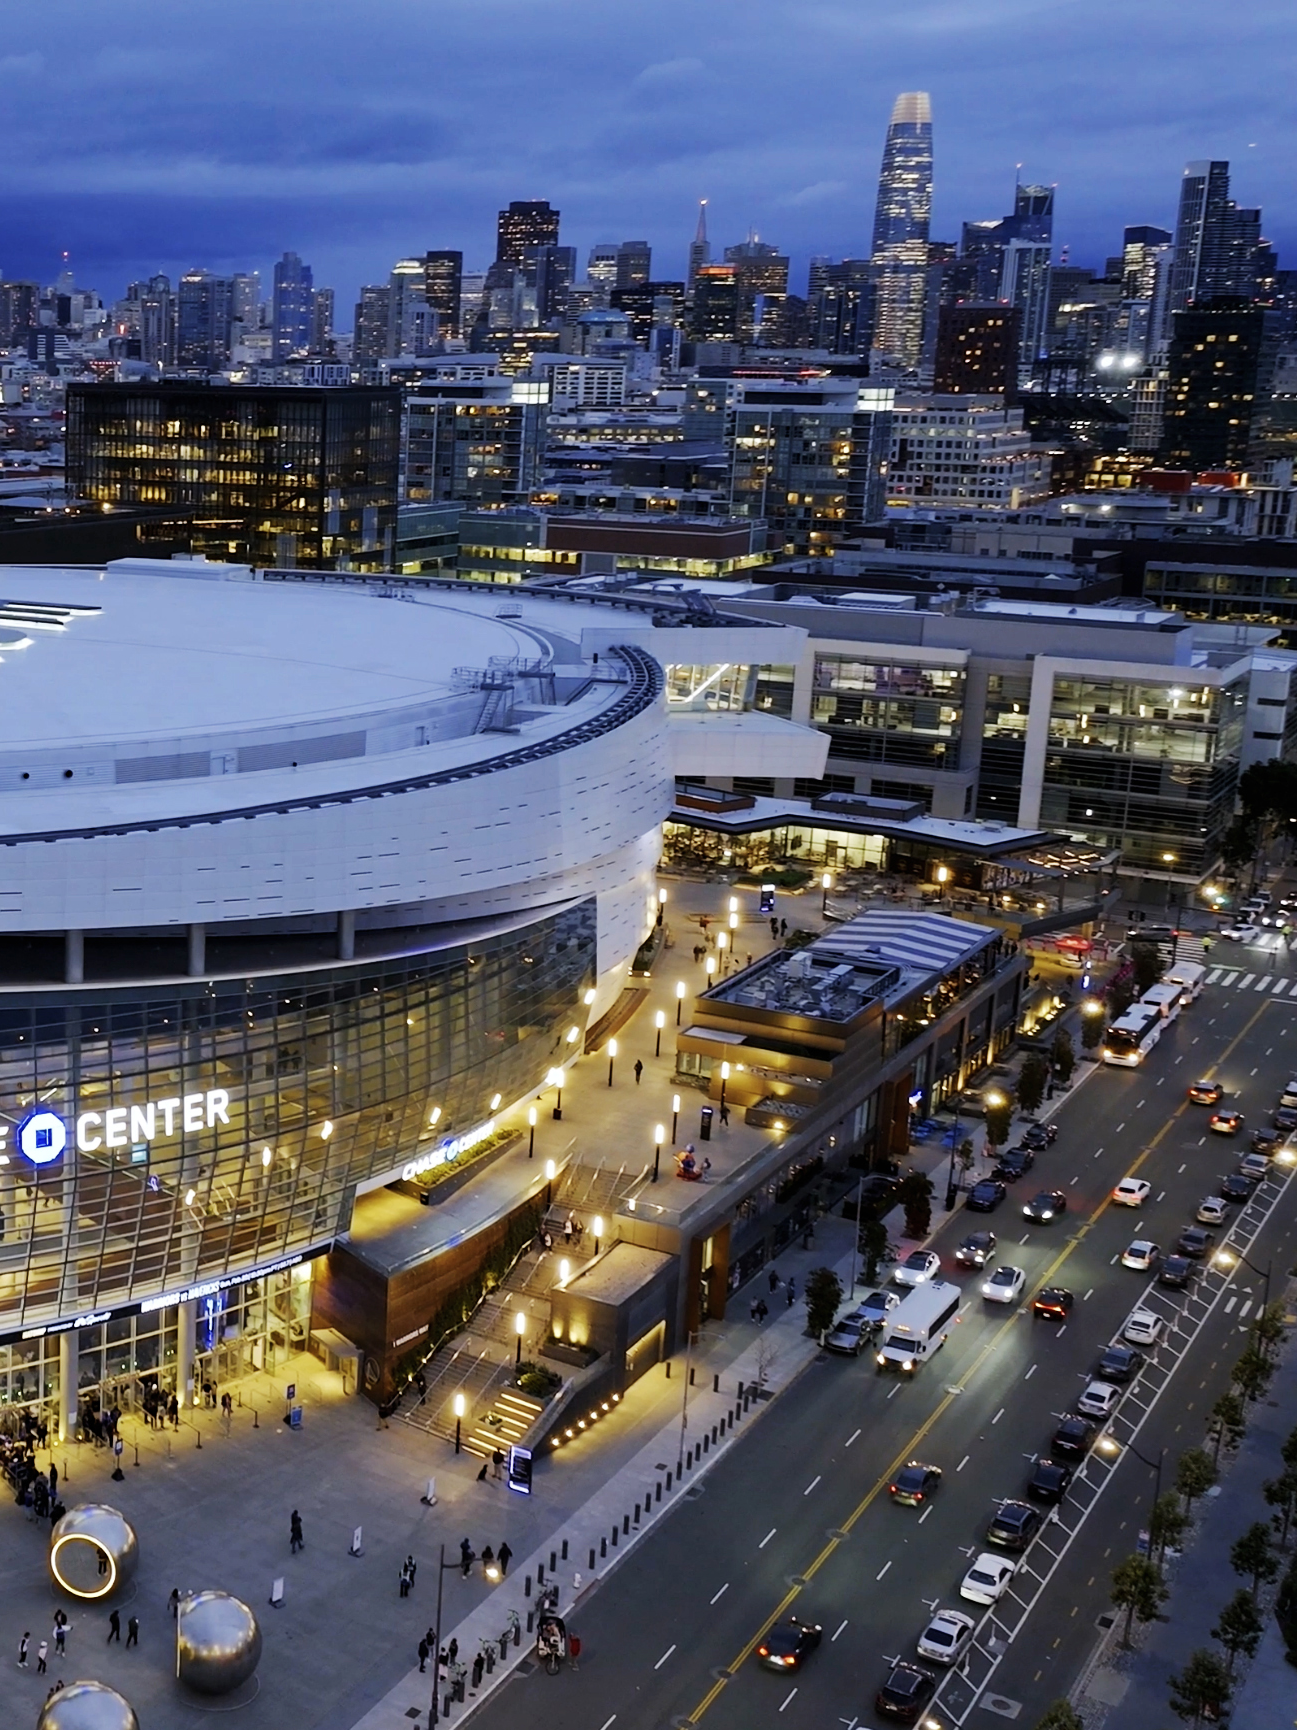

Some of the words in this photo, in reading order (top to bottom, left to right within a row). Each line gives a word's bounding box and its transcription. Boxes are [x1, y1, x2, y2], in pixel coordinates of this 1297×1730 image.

[77, 1089, 230, 1152] CENTER
[402, 1147, 447, 1181] CHASE
[458, 1120, 495, 1153] CENTER
